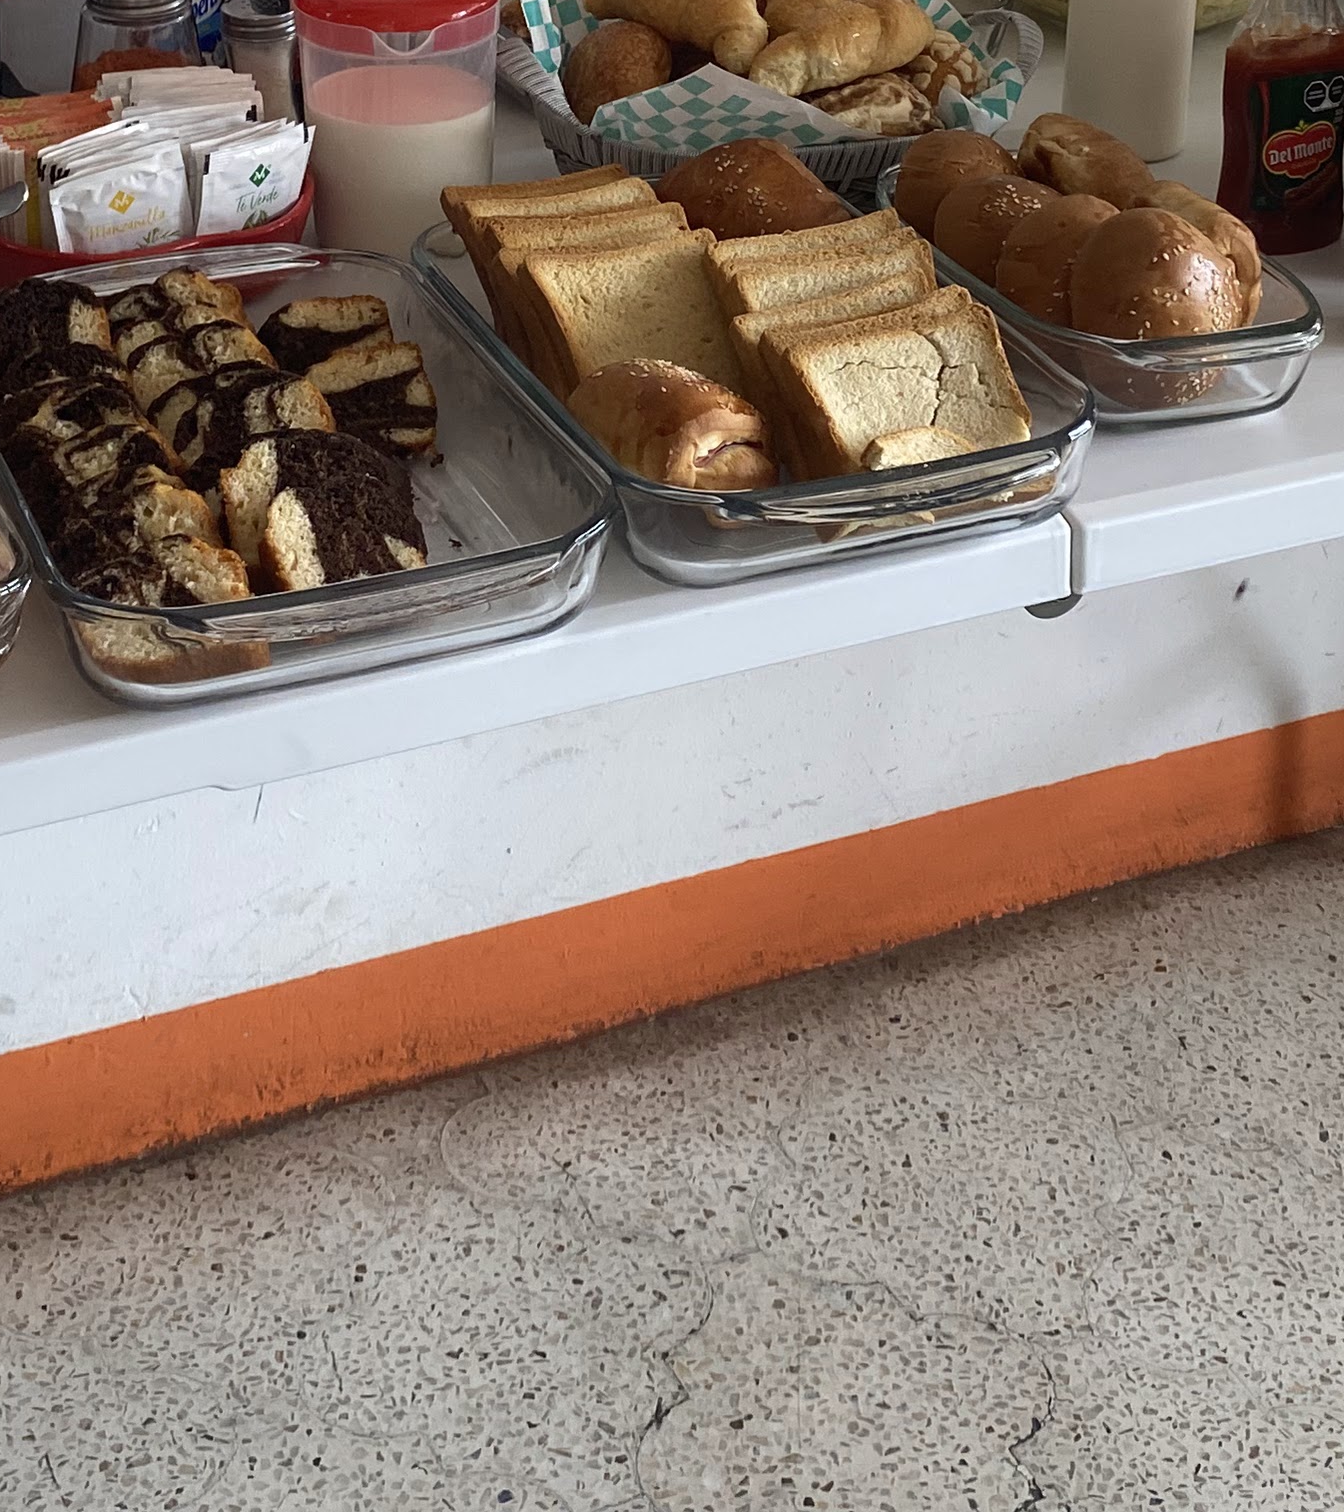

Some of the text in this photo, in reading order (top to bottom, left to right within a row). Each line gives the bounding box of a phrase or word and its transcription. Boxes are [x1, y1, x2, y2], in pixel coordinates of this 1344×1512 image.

[1268, 147, 1293, 165] Del
[1294, 136, 1333, 160] Monte
[250, 188, 279, 209] Verde
[89, 206, 166, 242] Manzanilla
